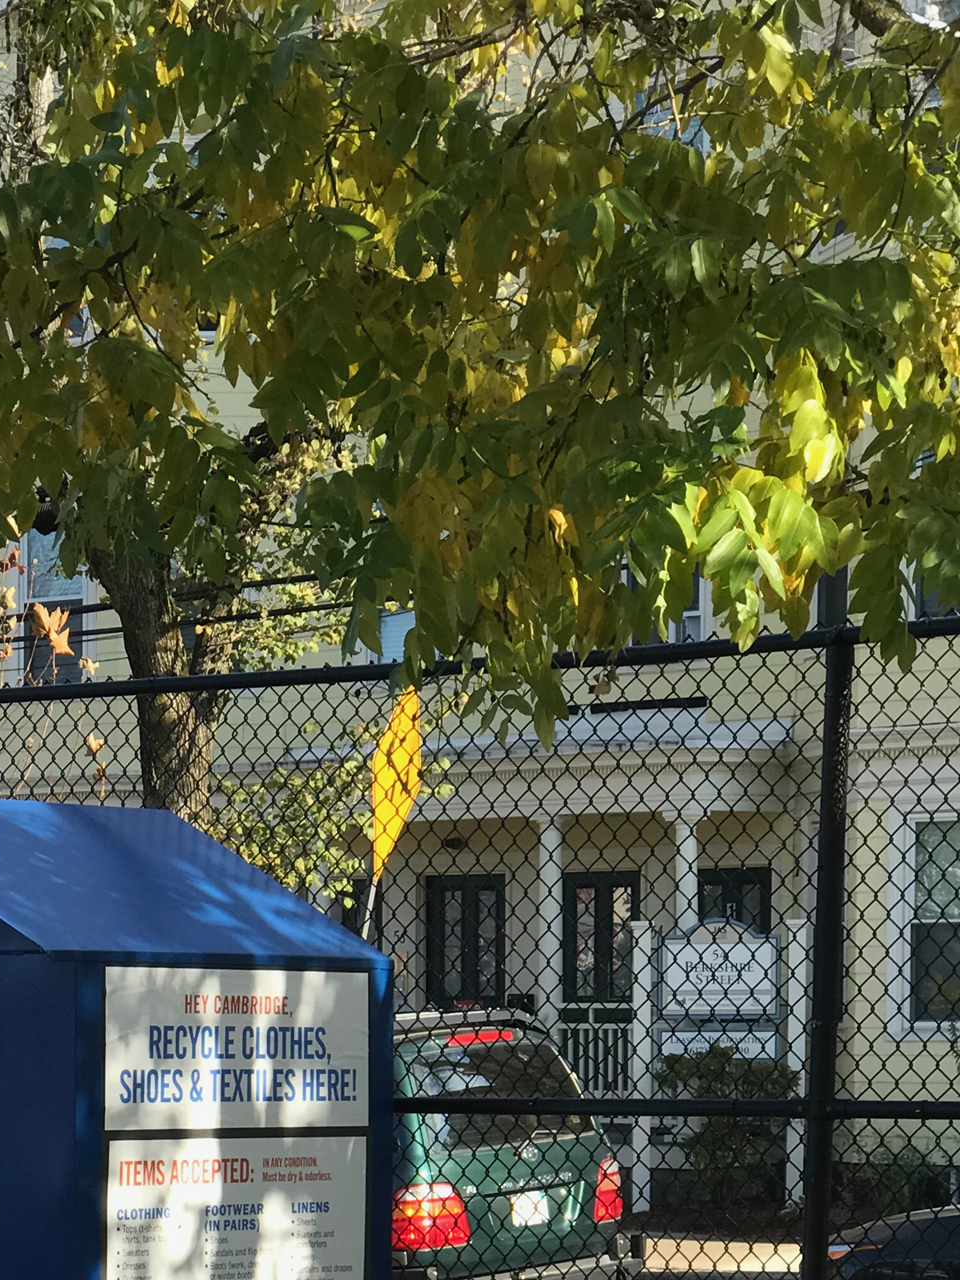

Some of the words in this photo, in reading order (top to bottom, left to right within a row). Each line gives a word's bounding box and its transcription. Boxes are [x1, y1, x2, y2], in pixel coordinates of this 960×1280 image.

[685, 961, 755, 973] BERKSHIRE
[695, 973, 741, 985] STREET
[184, 994, 209, 1014] HEY
[214, 995, 293, 1018] CAMBRIDGE,
[149, 1025, 236, 1060] RECYCLE
[242, 1025, 332, 1065] CLOTHES,
[119, 1069, 183, 1103] SHOES
[190, 1069, 203, 1102] &
[210, 1069, 296, 1102] TEXTILES
[302, 1069, 357, 1102] HERE!
[271, 1158, 283, 1167] ANY
[119, 1160, 165, 1186] ITEMS
[170, 1158, 254, 1185] ACCEPTED:
[263, 1172, 277, 1182] Must
[278, 1172, 286, 1181] be
[287, 1171, 297, 1183] dry
[205, 1203, 263, 1216] FOOTWEAR
[292, 1202, 330, 1213] LINENS
[117, 1207, 170, 1220] CLOTHING
[122, 1225, 137, 1234] Tops
[205, 1220, 222, 1234] (IN
[224, 1219, 260, 1232] PAIRS)
[323, 1230, 334, 1238] and
[210, 1236, 228, 1244] Shoes
[122, 1249, 149, 1257] Sweaters
[235, 1248, 246, 1256] and
[122, 1261, 146, 1270] Dresses
[210, 1262, 226, 1270] Boots
[333, 1264, 353, 1274] drapes
